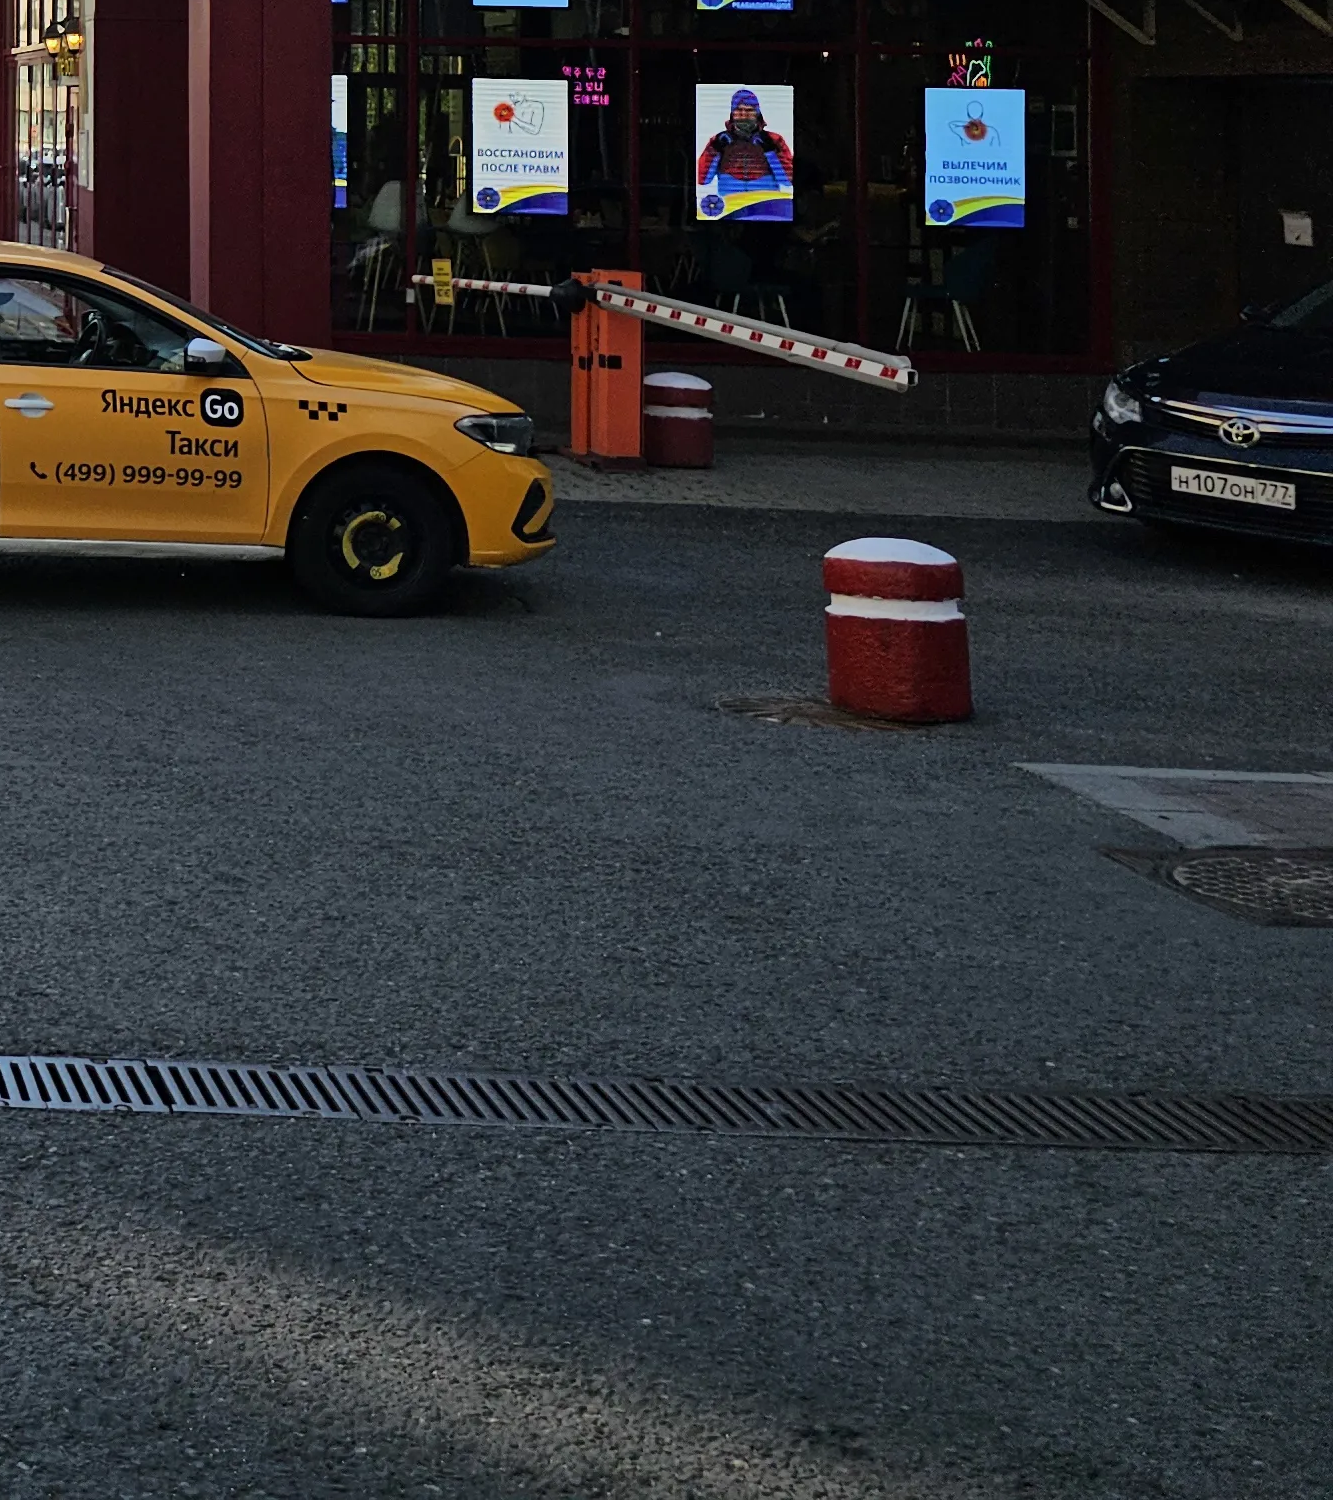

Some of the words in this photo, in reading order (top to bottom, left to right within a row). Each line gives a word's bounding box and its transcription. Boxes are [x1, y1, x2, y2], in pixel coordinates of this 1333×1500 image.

[477, 148, 564, 160] ВОССТАНОВИМ
[481, 163, 519, 173] ПОСЛЕ
[522, 164, 560, 174] ТРАВМ
[942, 160, 1008, 171] ВЫЛЕЧИМ
[929, 175, 1021, 186] ПОЗВОНОЧНИК
[101, 389, 196, 419] Яндекс
[204, 394, 240, 420] Go
[165, 430, 239, 458] Такси
[55, 461, 116, 487] (499)
[122, 465, 242, 489] 999-99-99
